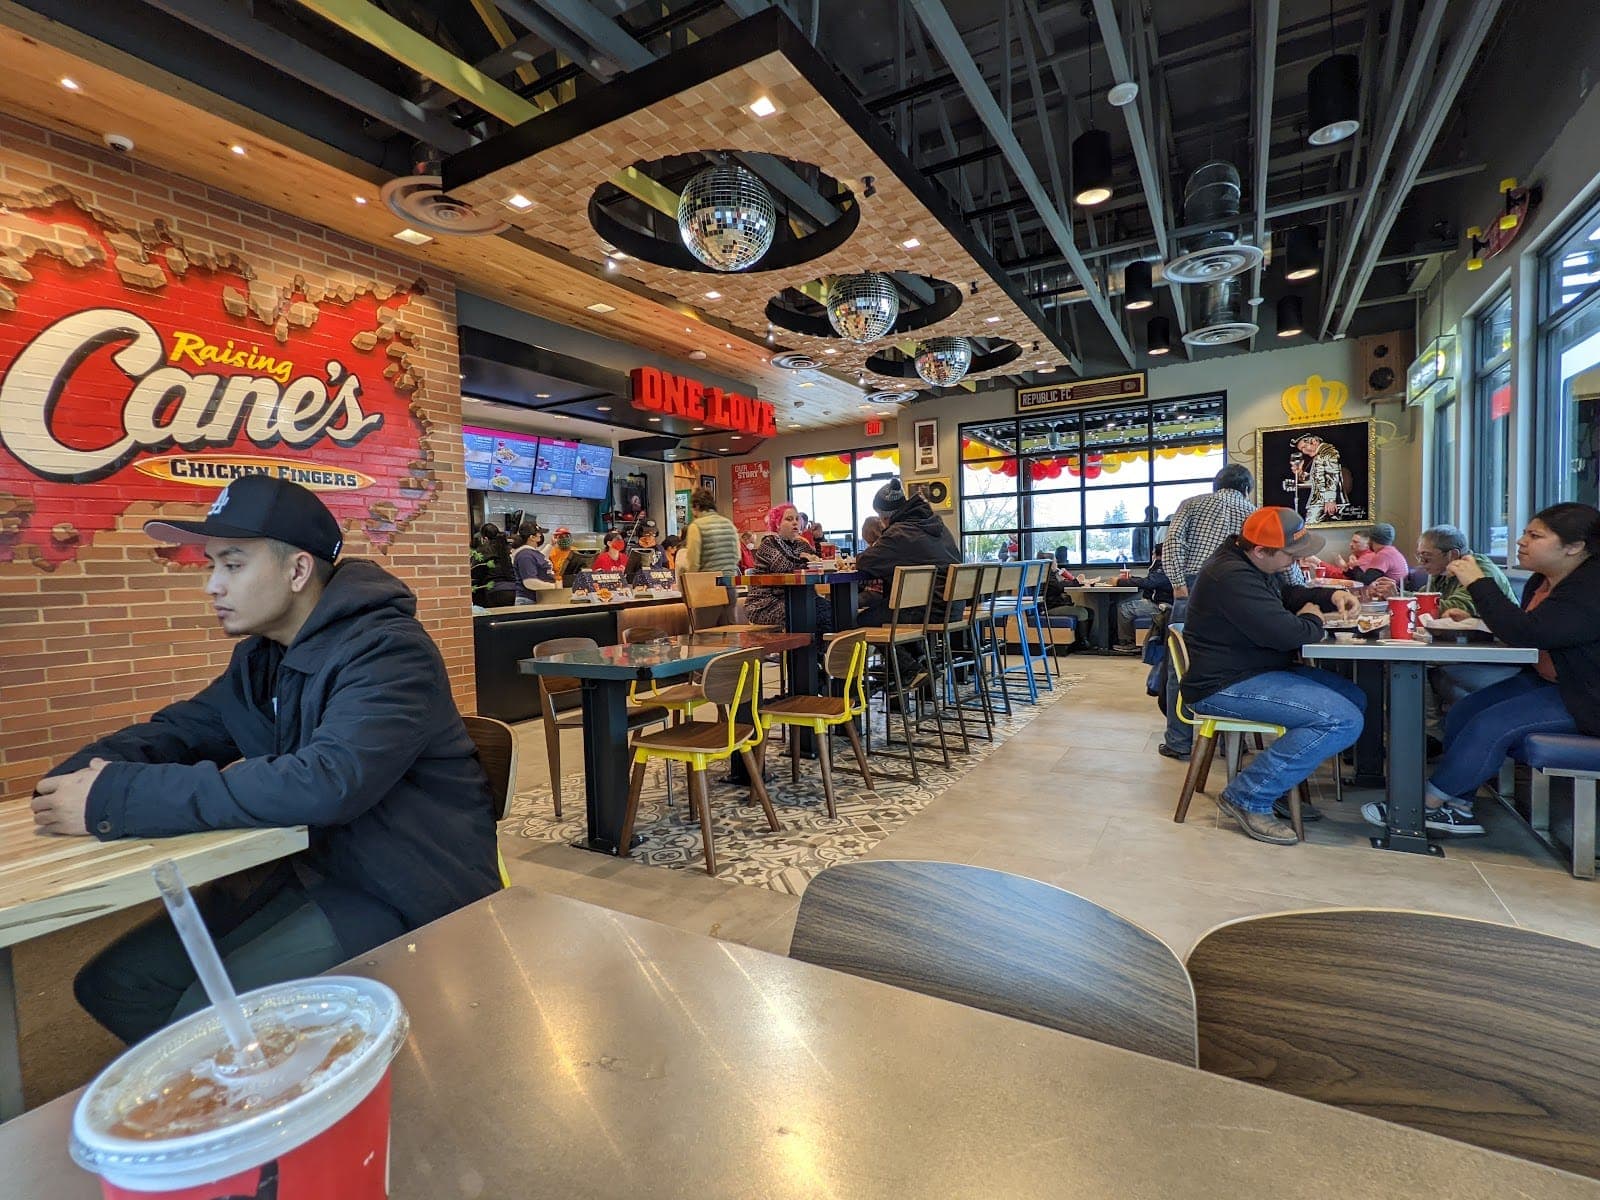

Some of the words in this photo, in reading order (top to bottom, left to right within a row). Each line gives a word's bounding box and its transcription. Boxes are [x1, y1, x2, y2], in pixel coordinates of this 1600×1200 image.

[173, 332, 293, 382] Raising
[1, 307, 382, 481] Cane's
[634, 367, 705, 421] ONE
[706, 387, 777, 437] LOVE
[1022, 391, 1058, 406] REPUBLIC
[1060, 387, 1072, 400] FC
[737, 471, 759, 479] STORY
